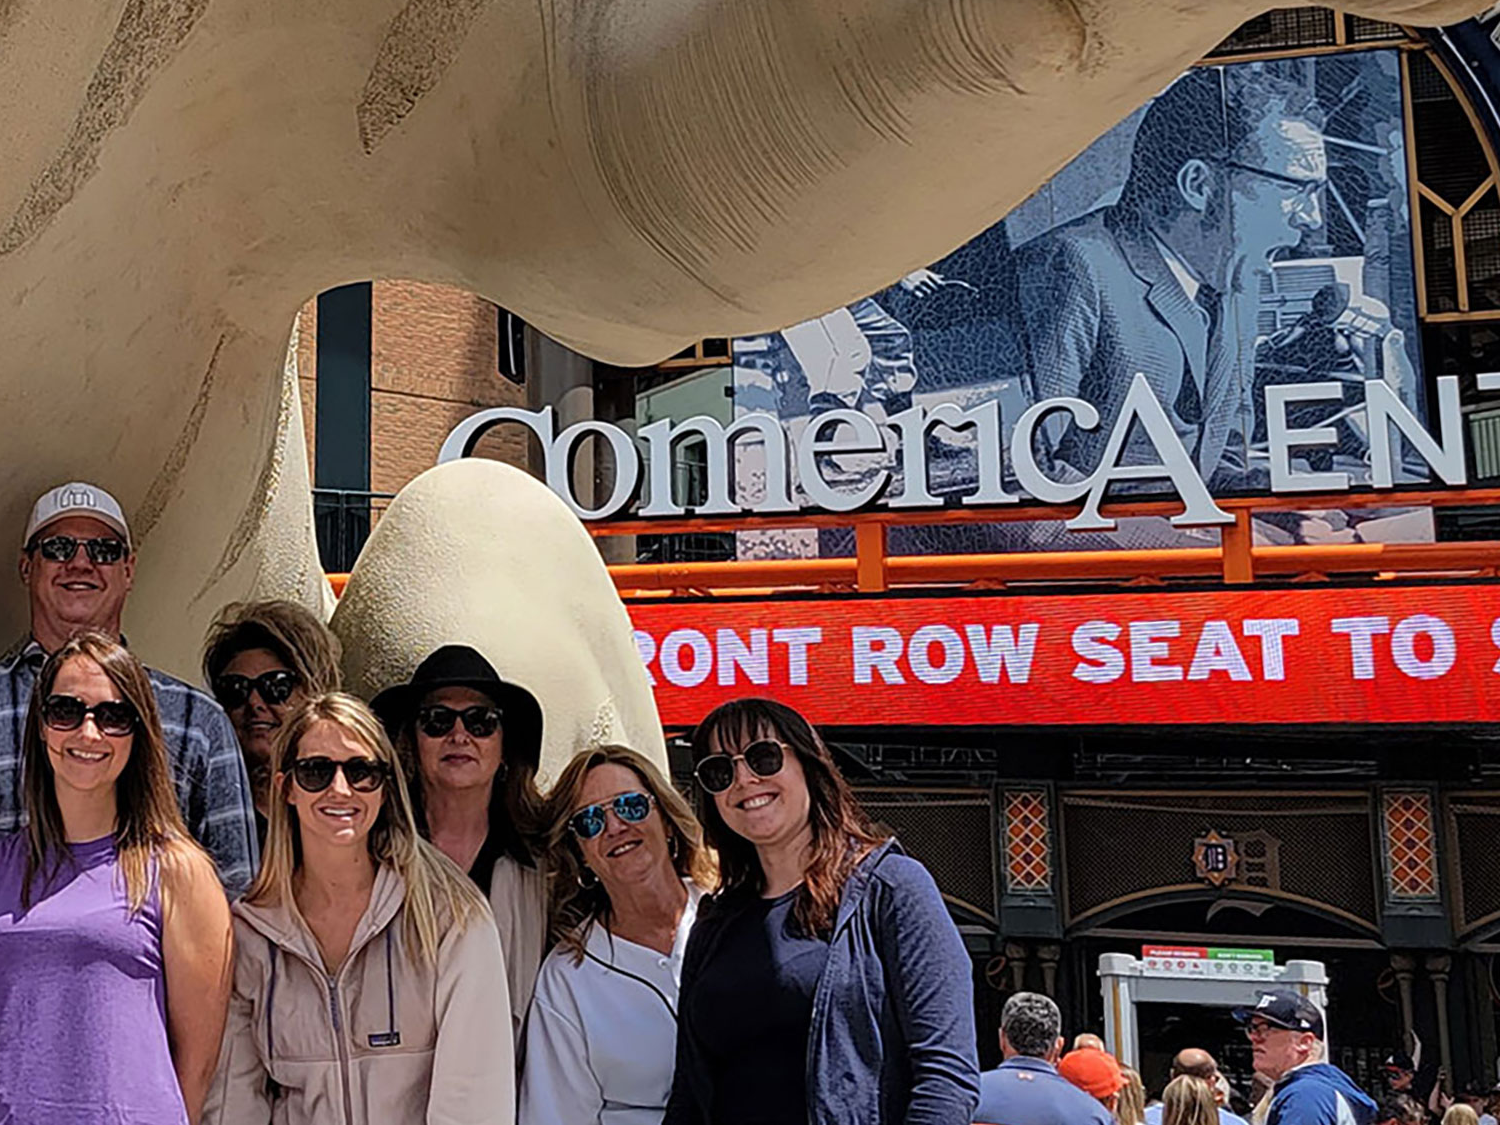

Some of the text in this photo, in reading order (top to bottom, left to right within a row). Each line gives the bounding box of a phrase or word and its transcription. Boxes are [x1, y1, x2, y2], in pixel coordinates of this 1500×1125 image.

[851, 622, 1041, 685] ROW
[1071, 618, 1300, 684] SEAT
[1330, 614, 1457, 680] TO
